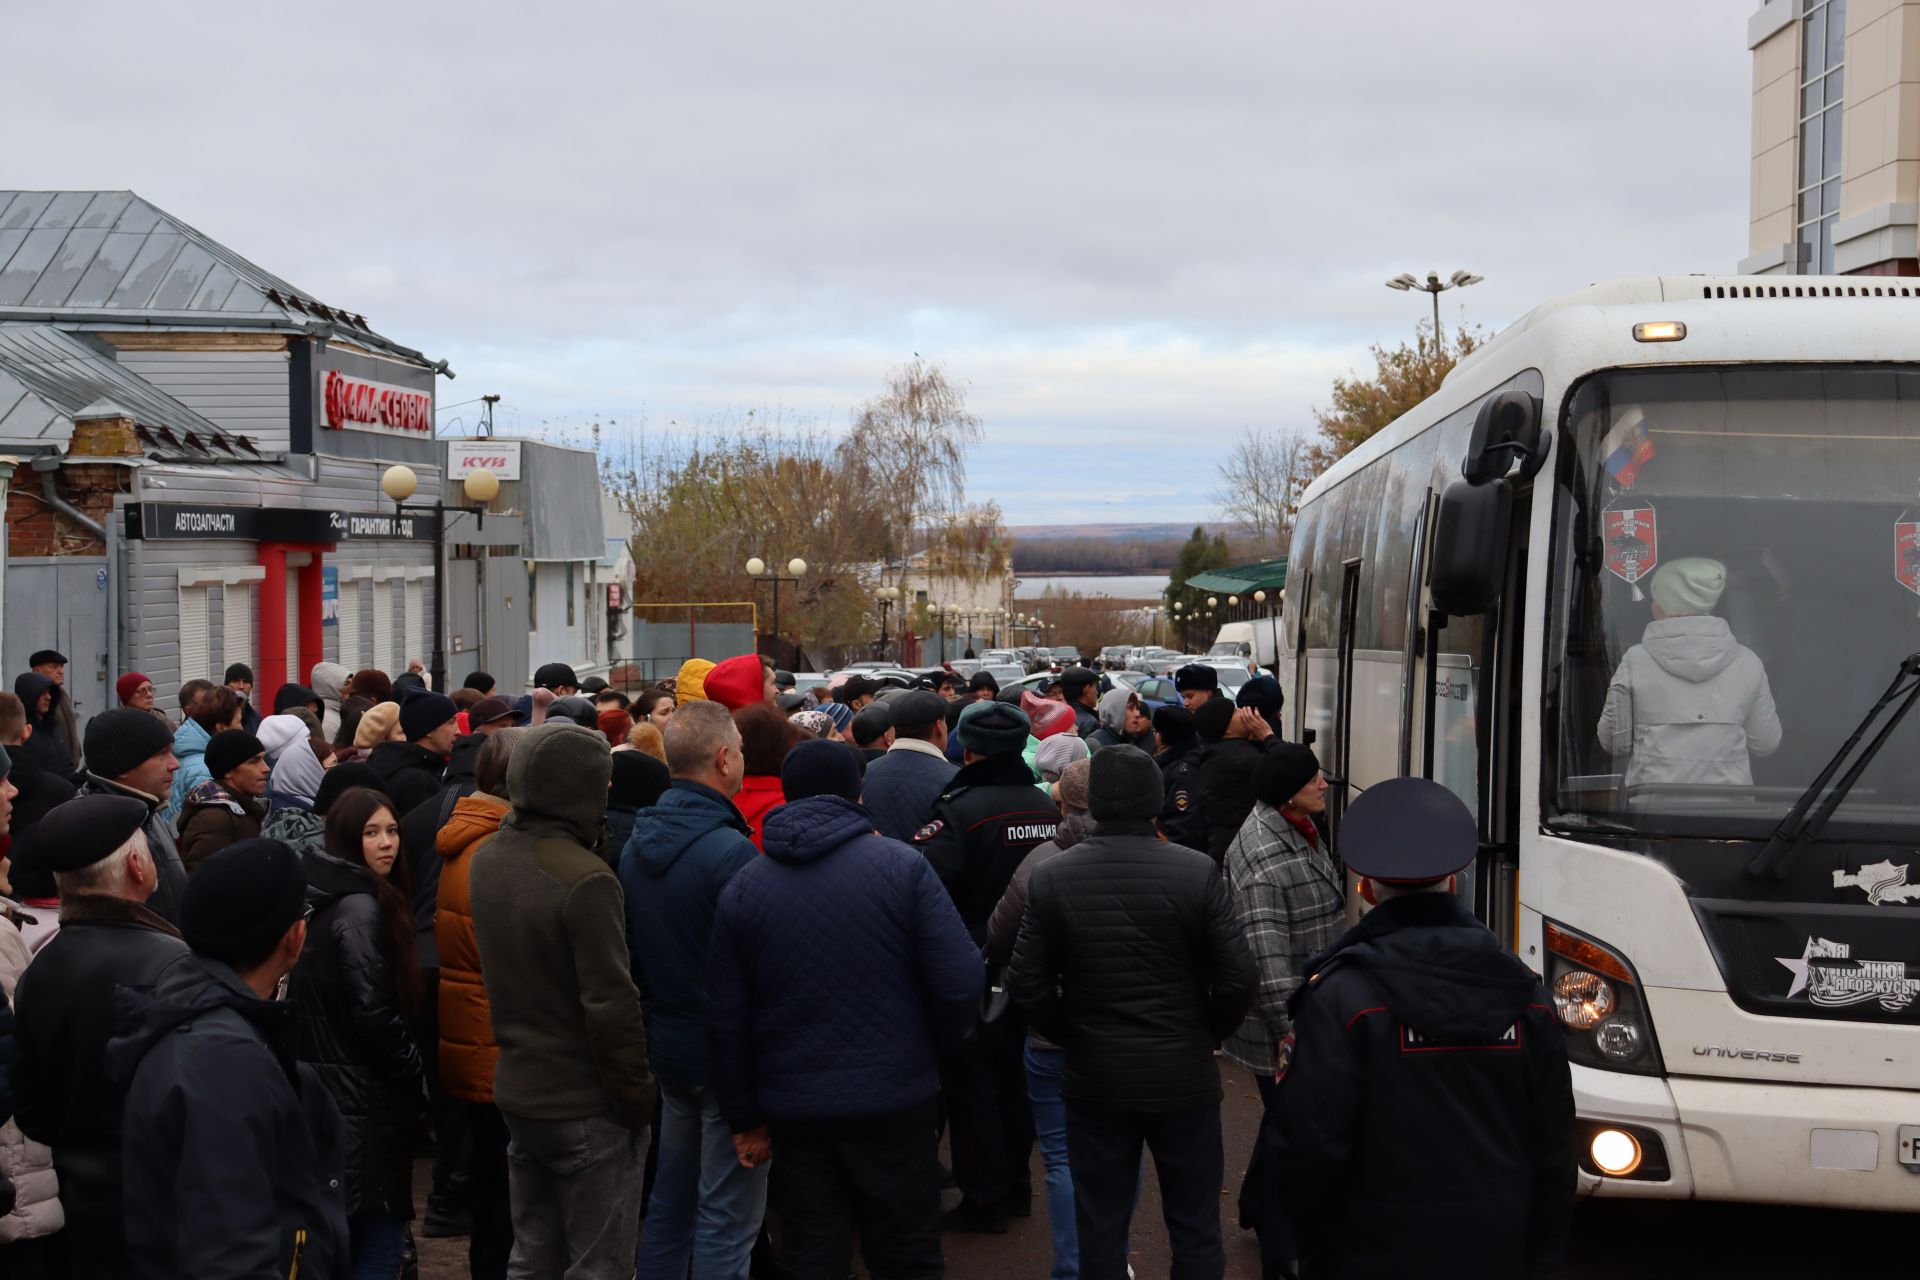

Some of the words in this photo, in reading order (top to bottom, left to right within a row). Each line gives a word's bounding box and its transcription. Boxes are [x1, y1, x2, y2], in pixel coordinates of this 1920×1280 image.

[175, 512, 235, 531] АВТОЗАПЧАСТИ
[350, 517, 391, 535] ГАРАНТИЯ
[392, 519, 396, 535] 1
[1007, 824, 1057, 840] ПОЛИЦИЯ
[1692, 1045, 1802, 1064] UNIVERSE
